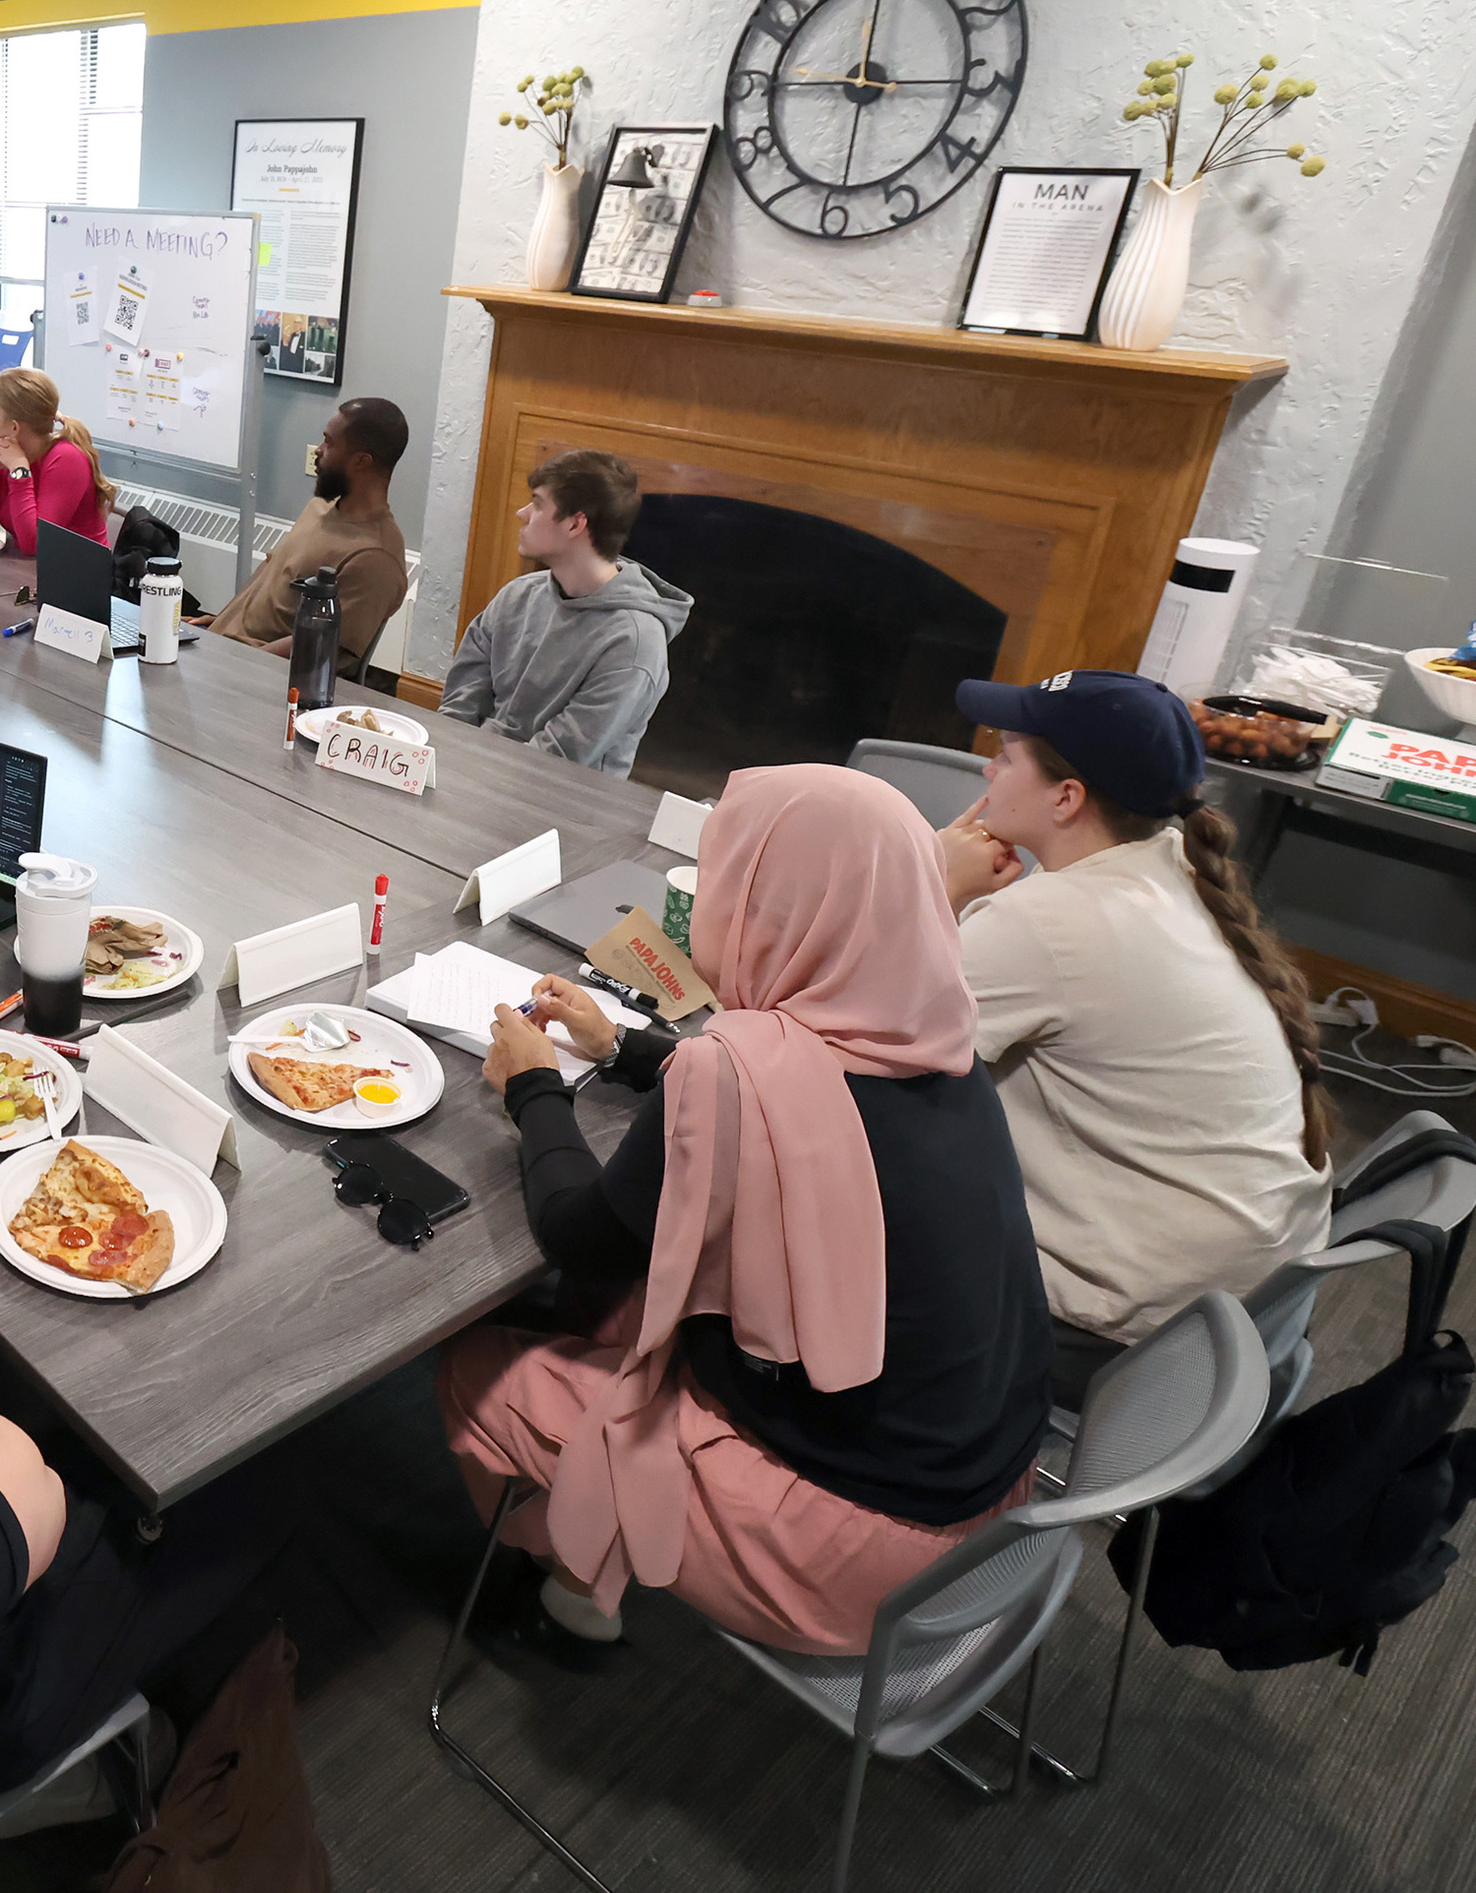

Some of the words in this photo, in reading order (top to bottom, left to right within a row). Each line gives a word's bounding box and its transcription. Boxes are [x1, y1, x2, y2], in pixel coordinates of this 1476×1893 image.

[262, 138, 298, 158] Loving
[301, 137, 348, 158] Memory
[267, 164, 282, 173] John
[284, 165, 318, 175] Pappajohn
[1034, 183, 1089, 201] MAN
[820, 187, 849, 238] 6
[1031, 203, 1054, 211] THE
[1061, 204, 1104, 212] ARENA
[85, 222, 121, 248] NEED
[125, 229, 139, 250] A
[146, 228, 229, 260] MEETING?
[327, 733, 409, 777] CRAIG
[629, 937, 659, 967] PAPA
[651, 962, 686, 1001] JOHNS
